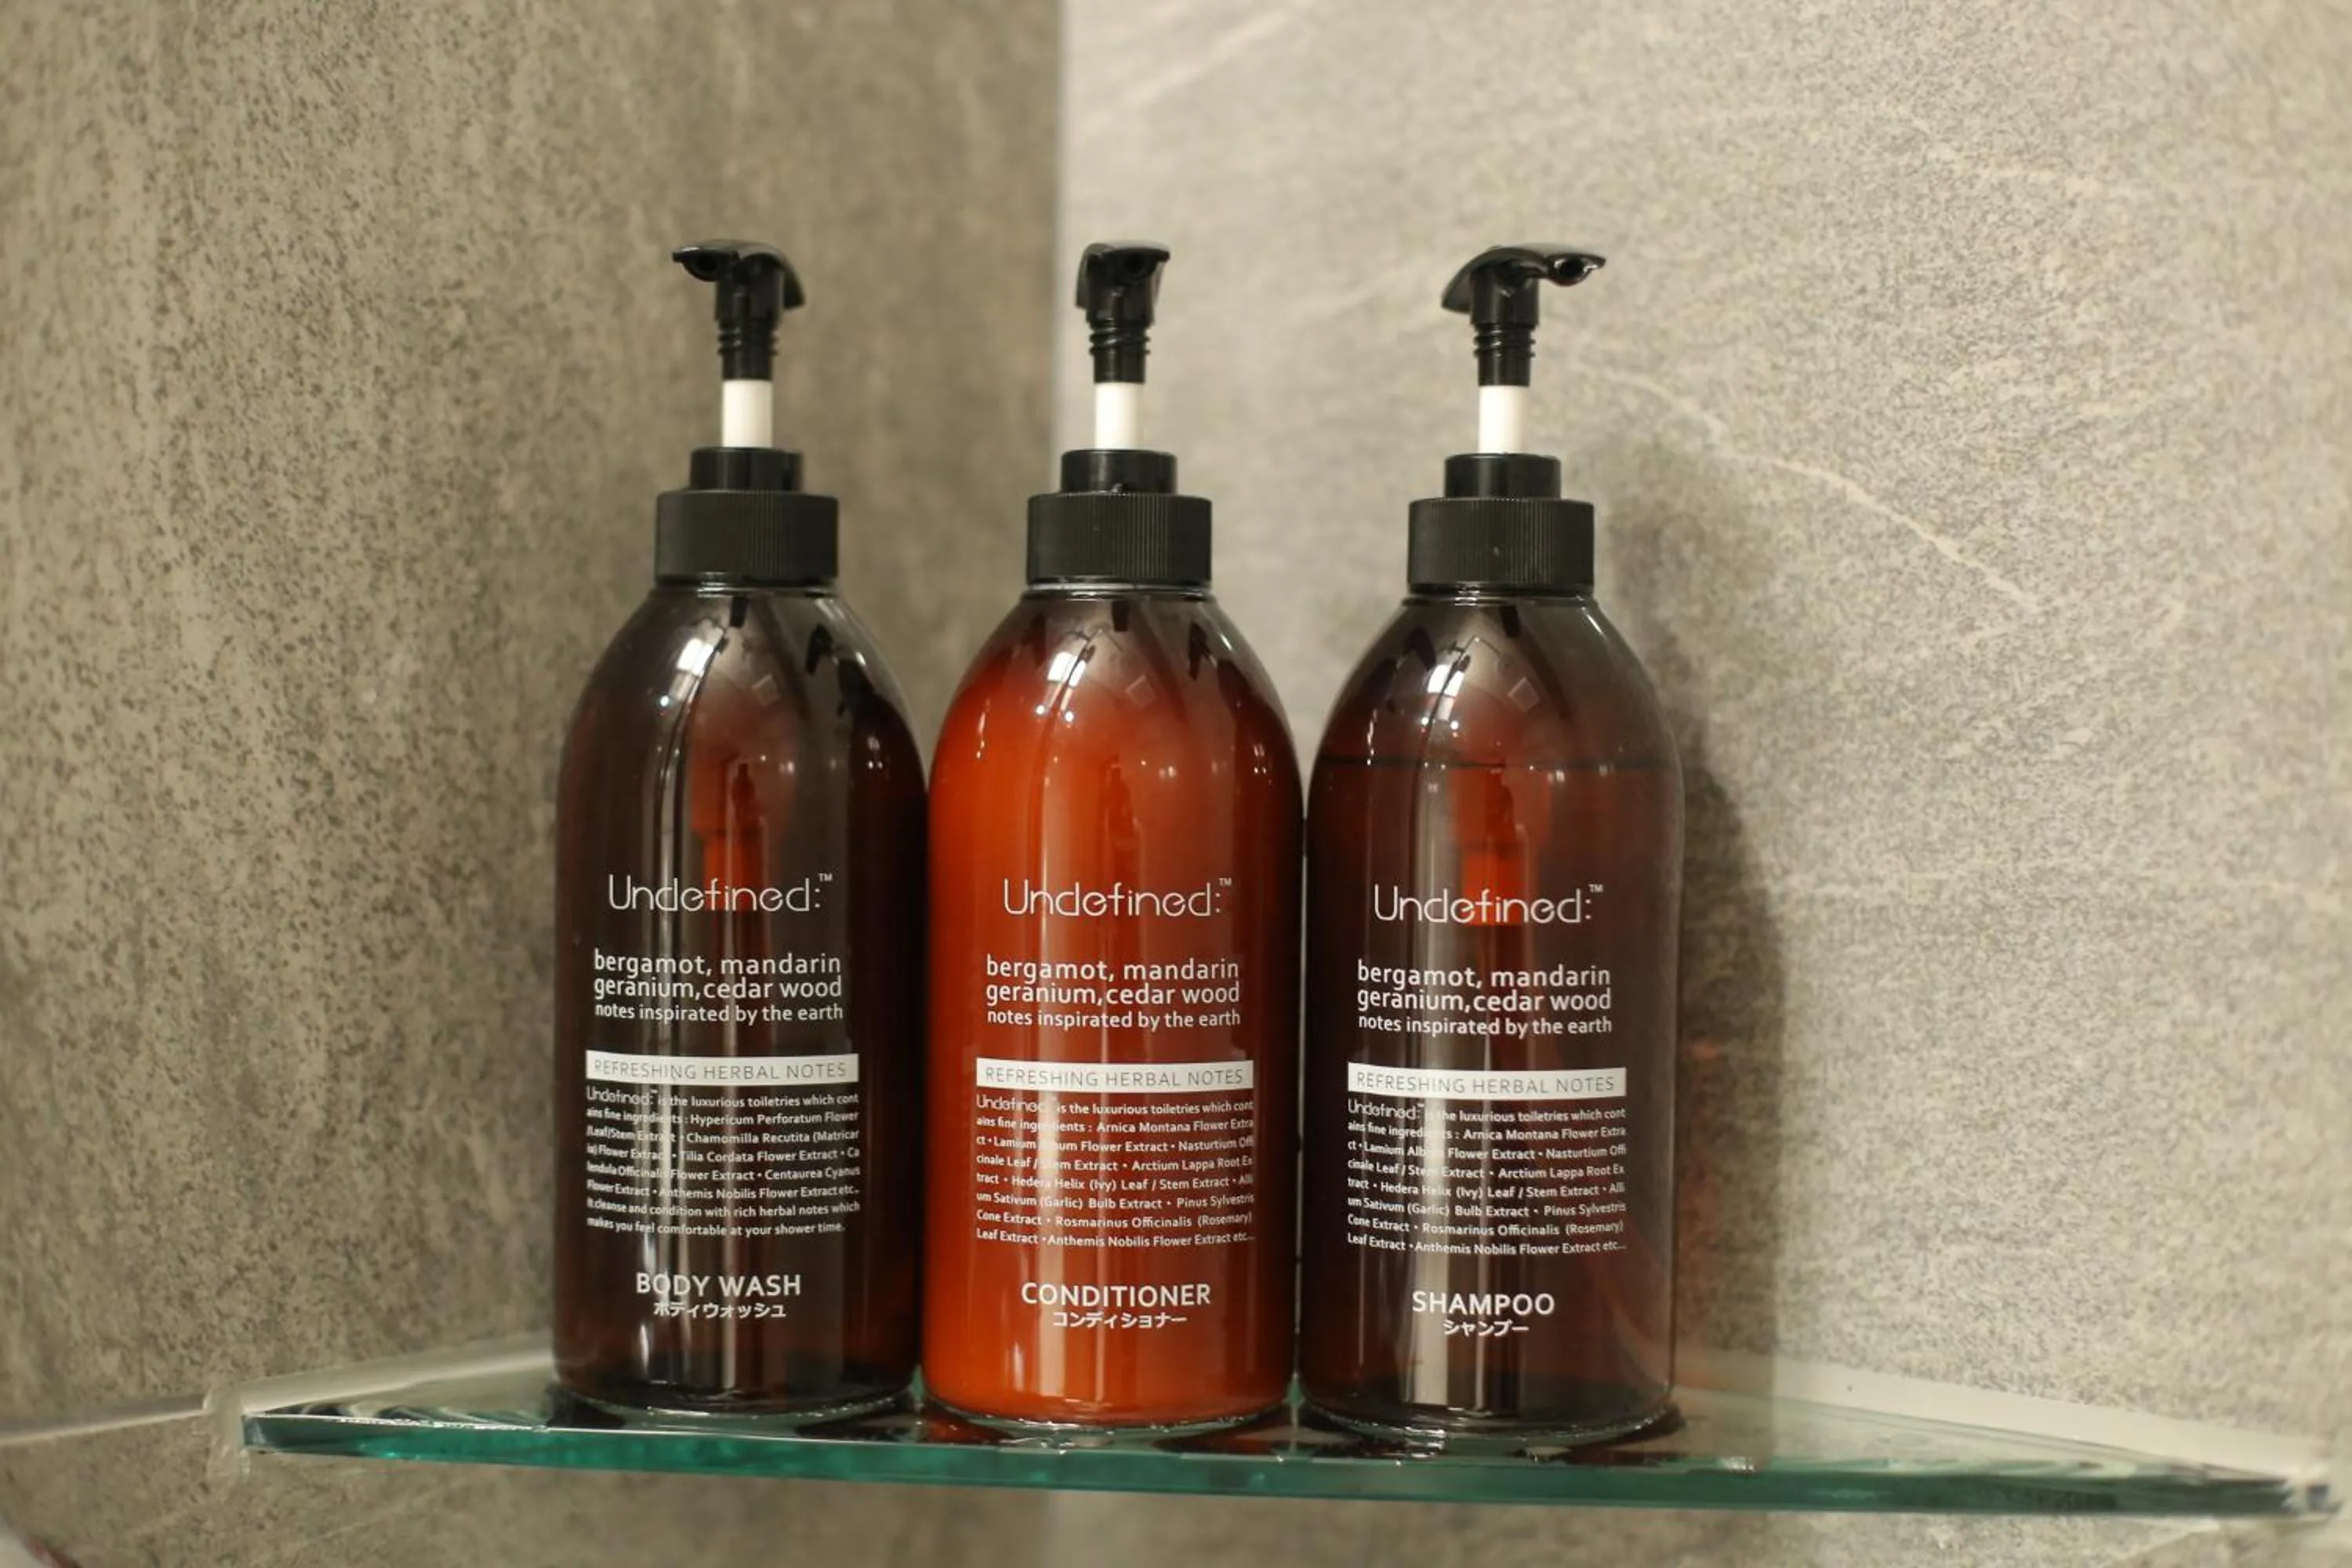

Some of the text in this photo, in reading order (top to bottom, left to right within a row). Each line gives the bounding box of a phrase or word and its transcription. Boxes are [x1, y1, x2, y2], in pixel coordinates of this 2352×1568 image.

[594, 948, 840, 978] bergamot, mandarin
[986, 954, 1238, 982] bergamot, mandarin
[1357, 959, 1610, 990] bergamot, mandarin
[780, 976, 841, 997] wood
[1181, 981, 1240, 1003] wood
[1551, 987, 1611, 1011] wood
[595, 1003, 844, 1025] notes inspirated by the earth
[987, 1010, 1240, 1032] notes inspirated by the earth
[1358, 1014, 1612, 1039] notes inspirated by the earth
[594, 1060, 846, 1080] REFRESHING HERBAL NOTES
[985, 1066, 1243, 1086] REFRESHING HERBAL NOTES
[1357, 1072, 1613, 1093] REFRESHING HERBAL NOTES
[691, 1096, 744, 1106] luxurious
[748, 1096, 800, 1106] toiletries
[803, 1094, 834, 1105] which
[1069, 1102, 1232, 1114] the luxurious toiletries which
[691, 1114, 753, 1127] Hypericum
[757, 1113, 822, 1124] Perforatum
[1459, 1110, 1515, 1121] luxurious
[1518, 1111, 1569, 1121] toiletries
[1571, 1109, 1602, 1120] which
[1139, 1123, 1190, 1132] Montana
[1193, 1121, 1229, 1131] Flower
[1505, 1129, 1559, 1140] Montana
[1561, 1128, 1599, 1138] Flower
[687, 1133, 809, 1144] Chamomilla Recutita
[1081, 1142, 1122, 1151] Flower
[1125, 1142, 1168, 1151] Extract
[757, 1152, 797, 1162] Flower
[800, 1149, 837, 1160] Extract
[1448, 1147, 1487, 1159] Flower
[1492, 1149, 1535, 1160] Extract
[1074, 1160, 1118, 1171] Extract
[1132, 1160, 1179, 1171] Arctium
[1182, 1160, 1214, 1171] Lappa
[1218, 1157, 1240, 1167] Root
[1377, 1163, 1399, 1174] Leaf
[1442, 1167, 1484, 1178] Extract
[1587, 1165, 1610, 1176] Root
[712, 1170, 754, 1180] Extract
[765, 1169, 822, 1180] Centaurea
[1121, 1179, 1148, 1190] Leaf
[1160, 1179, 1189, 1189] Stem
[1193, 1178, 1229, 1188] Extract
[1381, 1182, 1419, 1194] Hedera
[1487, 1187, 1515, 1197] Leaf
[1526, 1187, 1557, 1197] Stem
[1560, 1185, 1599, 1196] Extract
[717, 1189, 757, 1199] Nobilis
[759, 1189, 798, 1198] Flower
[629, 1204, 647, 1214] and
[706, 1207, 730, 1217] with
[734, 1206, 756, 1217] rich
[759, 1205, 795, 1216] herbal
[799, 1205, 829, 1214] notes
[1089, 1197, 1207, 1209] Bulb Extract Pinus
[1455, 1205, 1483, 1216] Bulb
[1486, 1206, 1530, 1217] Extract
[1544, 1205, 1576, 1215] Pinus
[1004, 1212, 1042, 1225] Extract
[1131, 1217, 1192, 1228] Officinalis
[1374, 1218, 1410, 1232] Extract
[1422, 1223, 1494, 1235] Rosmarinus
[615, 1222, 632, 1232] you
[730, 1225, 742, 1235] at
[746, 1225, 771, 1238] your
[775, 1223, 815, 1234] shower
[1000, 1231, 1038, 1243] Extract
[1048, 1236, 1105, 1246] Anthemis
[1109, 1236, 1150, 1247] Nobilis
[1153, 1236, 1192, 1246] Flower
[1195, 1233, 1231, 1244] Extract
[1348, 1232, 1600, 1254] Leaf Extract Anthemis Nobilis Flower Extract
[637, 1272, 801, 1297] BODY WASH
[1022, 1282, 1210, 1307] CONDITIONER
[1412, 1290, 1555, 1316] SHAMPOO
